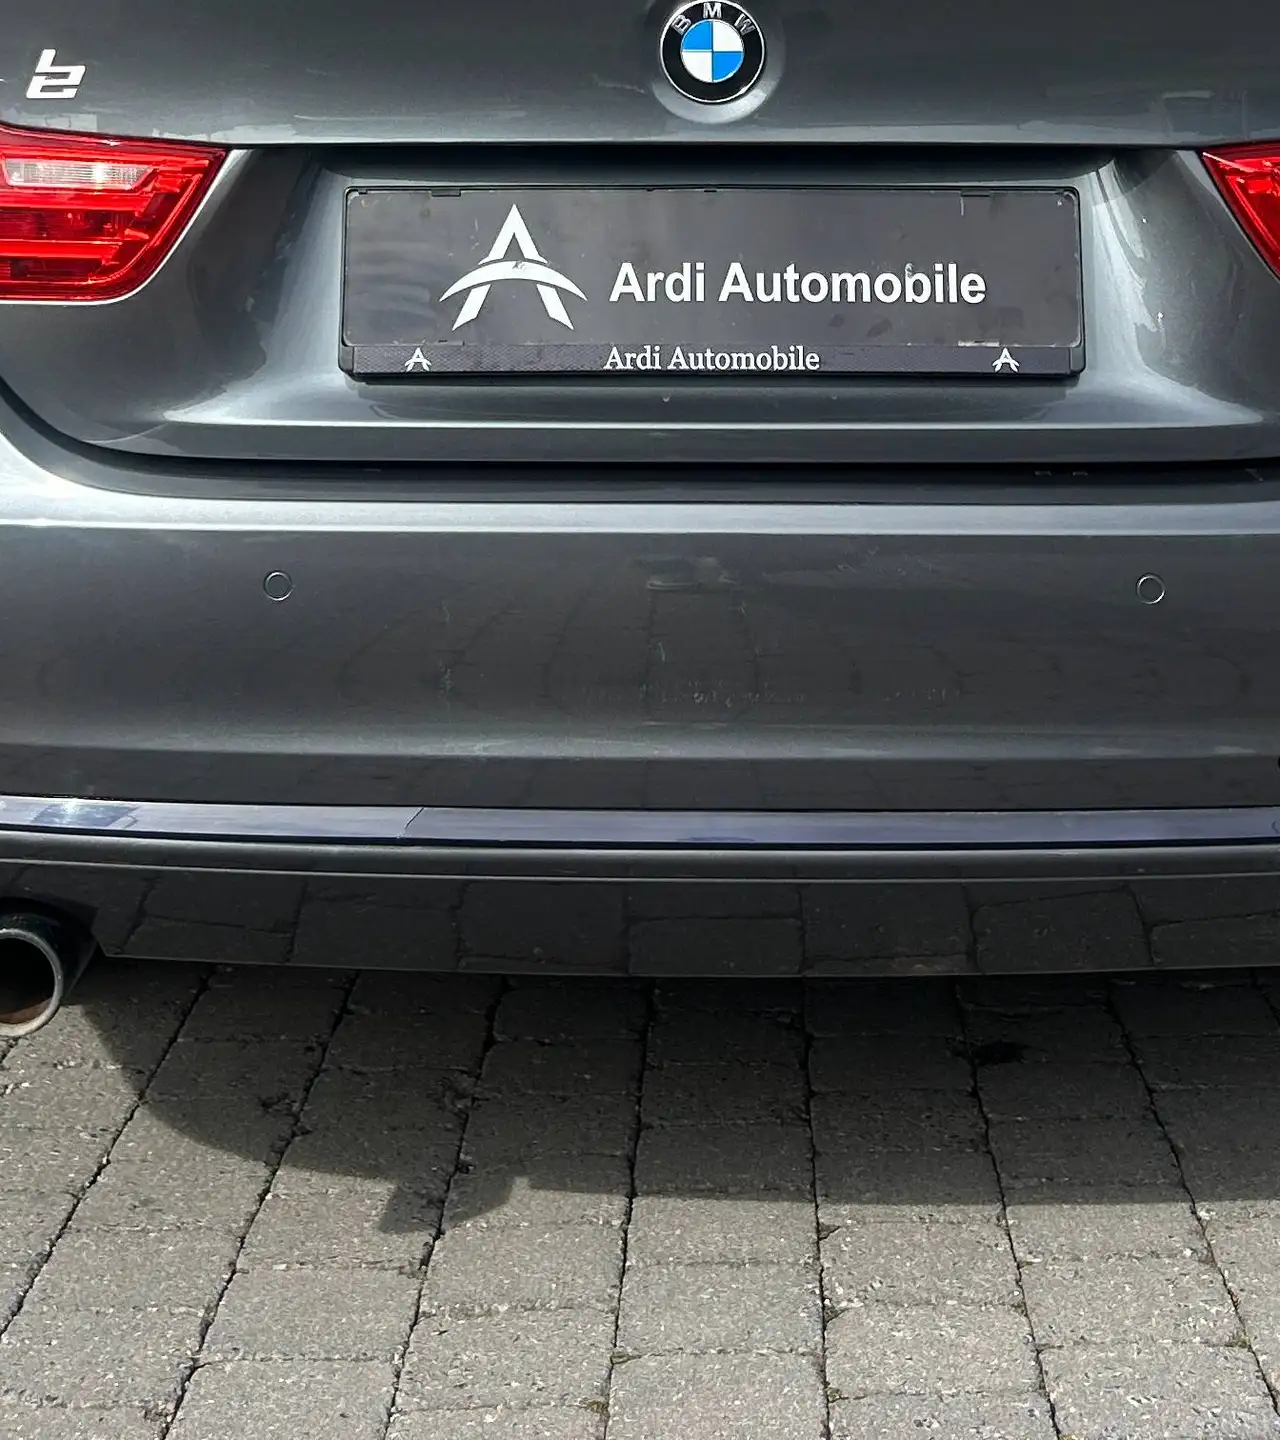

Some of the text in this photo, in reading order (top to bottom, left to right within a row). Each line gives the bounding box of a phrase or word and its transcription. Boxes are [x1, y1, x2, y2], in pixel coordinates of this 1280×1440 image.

[671, 2, 756, 36] BMW
[608, 261, 987, 304] Ardi Automobile
[602, 345, 820, 371] Ardi Automobile
